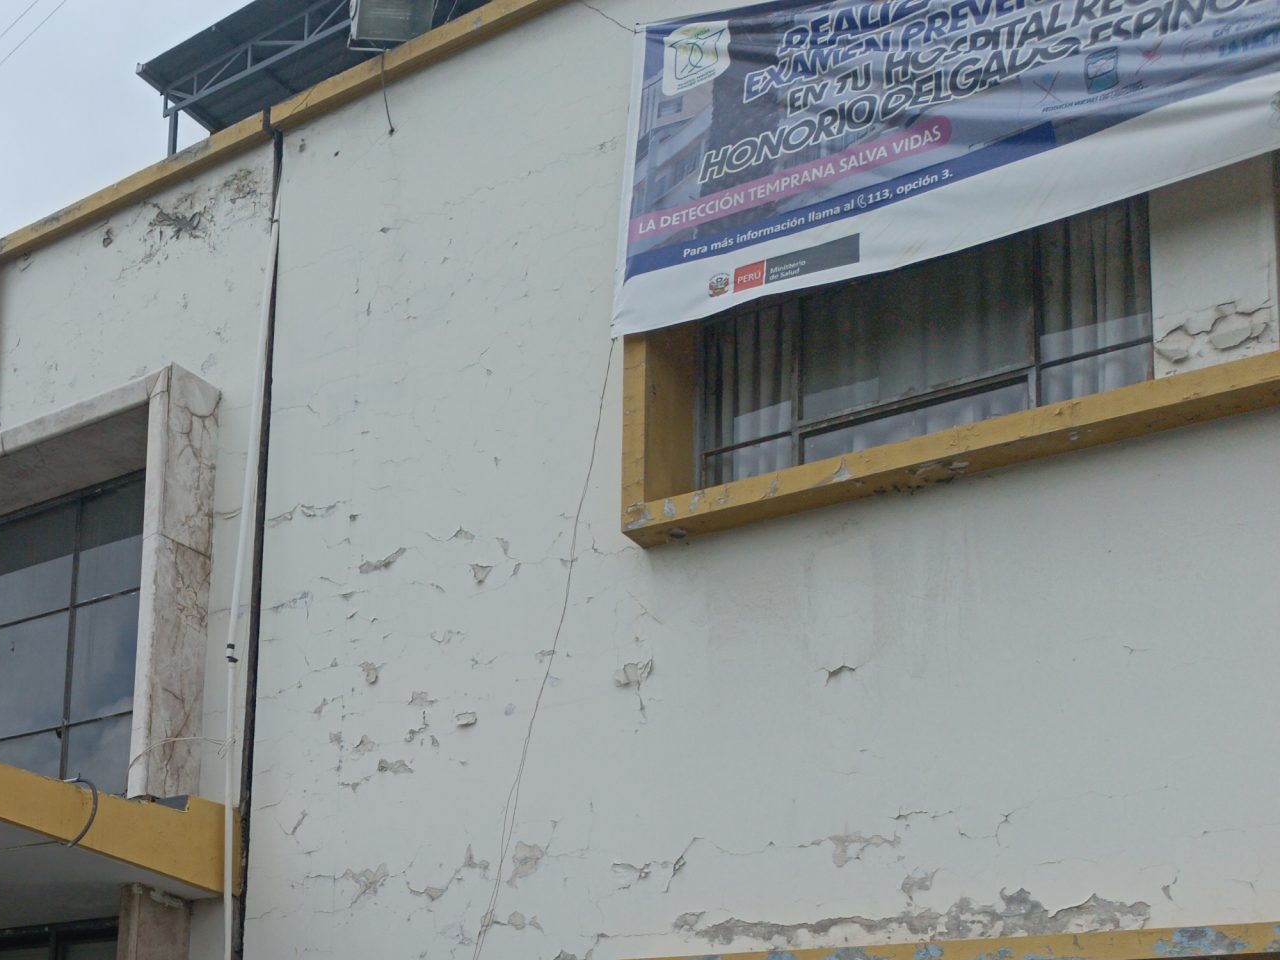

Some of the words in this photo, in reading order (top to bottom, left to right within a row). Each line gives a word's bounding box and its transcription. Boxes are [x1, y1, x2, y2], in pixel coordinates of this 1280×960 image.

[743, 30, 893, 103] EXAMEN
[787, 81, 830, 117] EN
[835, 61, 872, 95] TU
[883, 1, 1068, 89] HOSPITAL
[698, 94, 879, 184] HONORIO
[879, 37, 1081, 121] DELGADO
[638, 219, 656, 235] LA
[659, 190, 745, 228] DETECCIÓN
[748, 162, 836, 203] TEMPRANA
[839, 146, 888, 172] SALVA
[892, 124, 942, 155] VIDAS
[683, 244, 708, 257] Para
[710, 236, 734, 252] más
[736, 215, 806, 245] información
[808, 206, 841, 223] llama
[843, 199, 855, 212] al
[867, 187, 893, 204] 113,
[895, 173, 939, 197] opción
[941, 168, 954, 181] 3.
[737, 269, 761, 287] PERÚ
[770, 259, 807, 274] Ministerio
[770, 272, 778, 281] de
[779, 268, 800, 279] Salud
